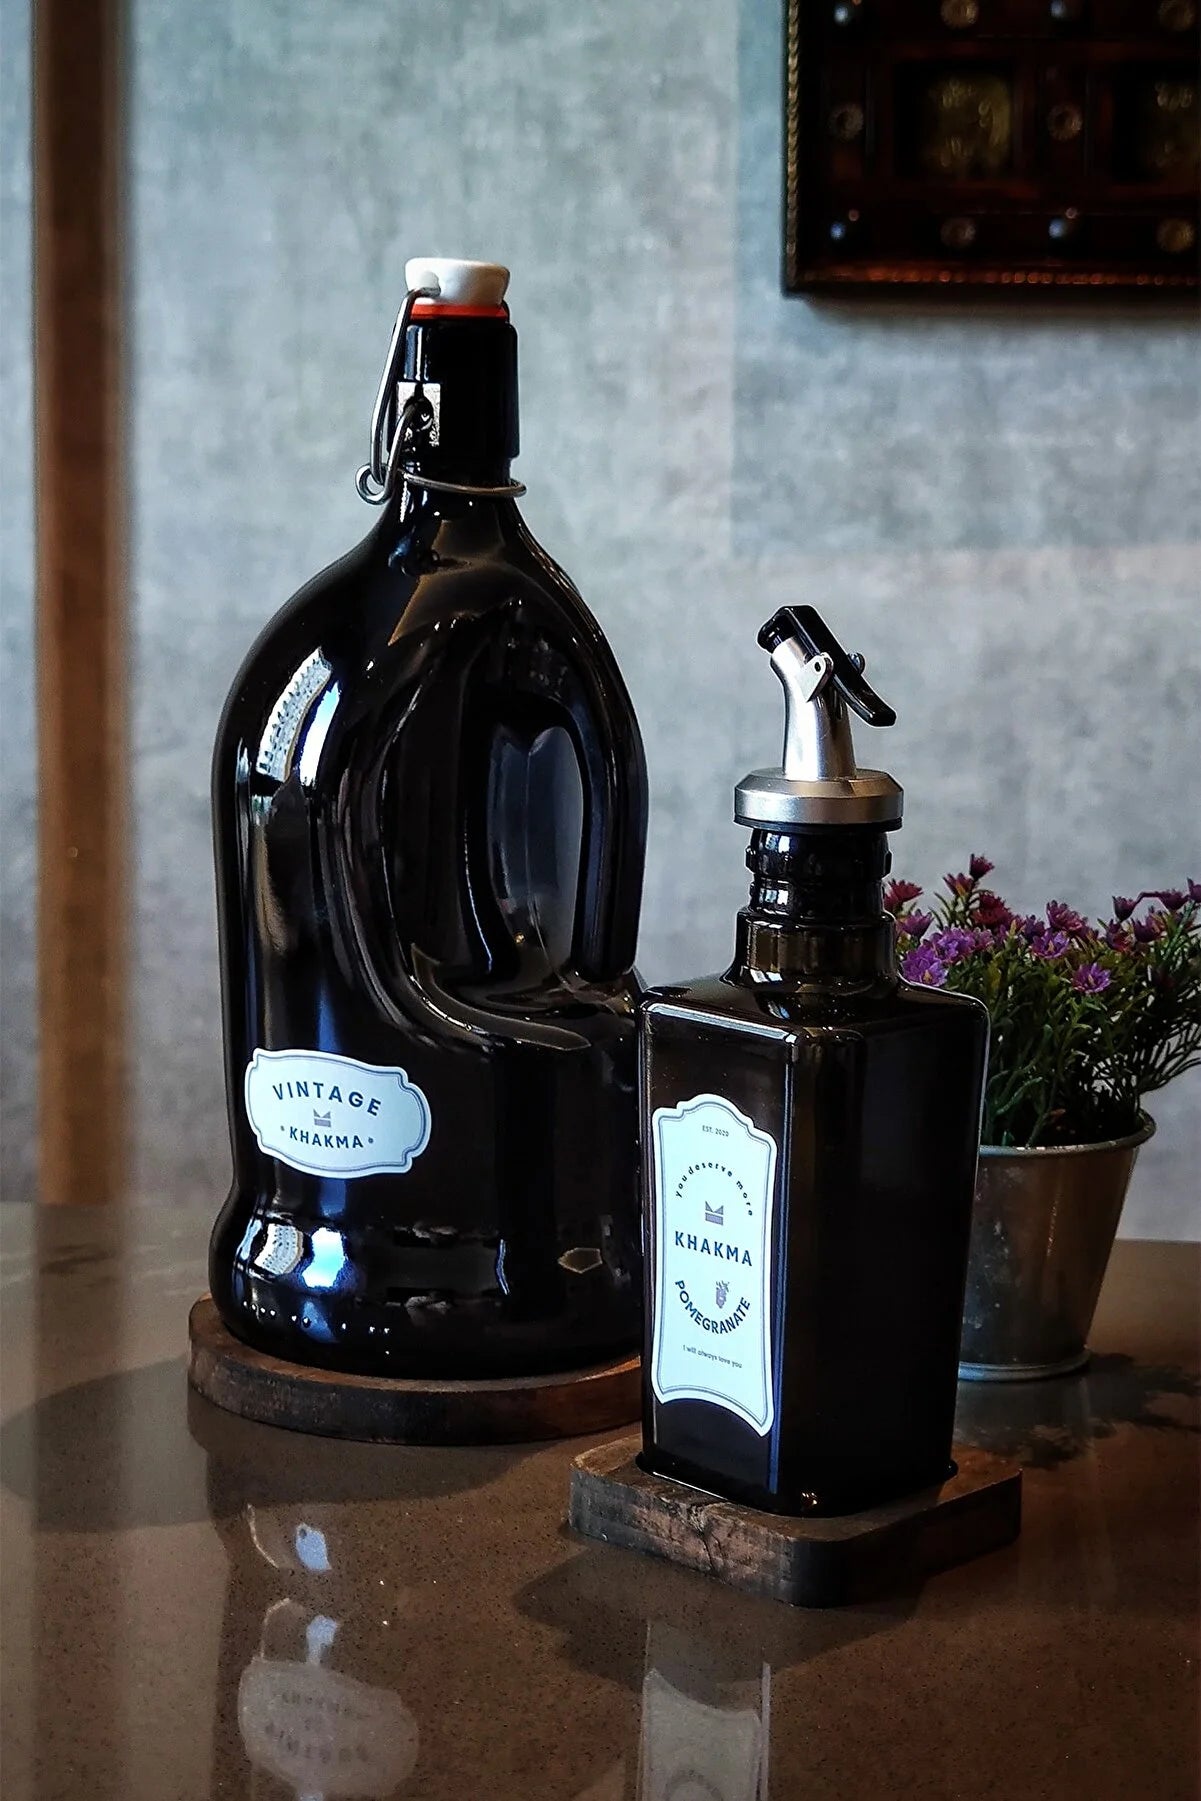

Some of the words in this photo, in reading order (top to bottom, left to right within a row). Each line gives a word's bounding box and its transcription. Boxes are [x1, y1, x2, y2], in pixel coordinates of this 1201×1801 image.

[272, 1080, 382, 1117] VINTAGE
[289, 1125, 364, 1149] KHAKMA
[675, 1174, 688, 1198] you
[688, 1162, 733, 1177] deserve
[736, 1180, 753, 1216] more
[674, 1230, 753, 1267] KHAKMA
[674, 1279, 751, 1335] POMEGRANATE
[686, 1346, 697, 1354] will
[697, 1349, 718, 1361] always
[718, 1355, 731, 1365] love
[731, 1360, 743, 1369] you
